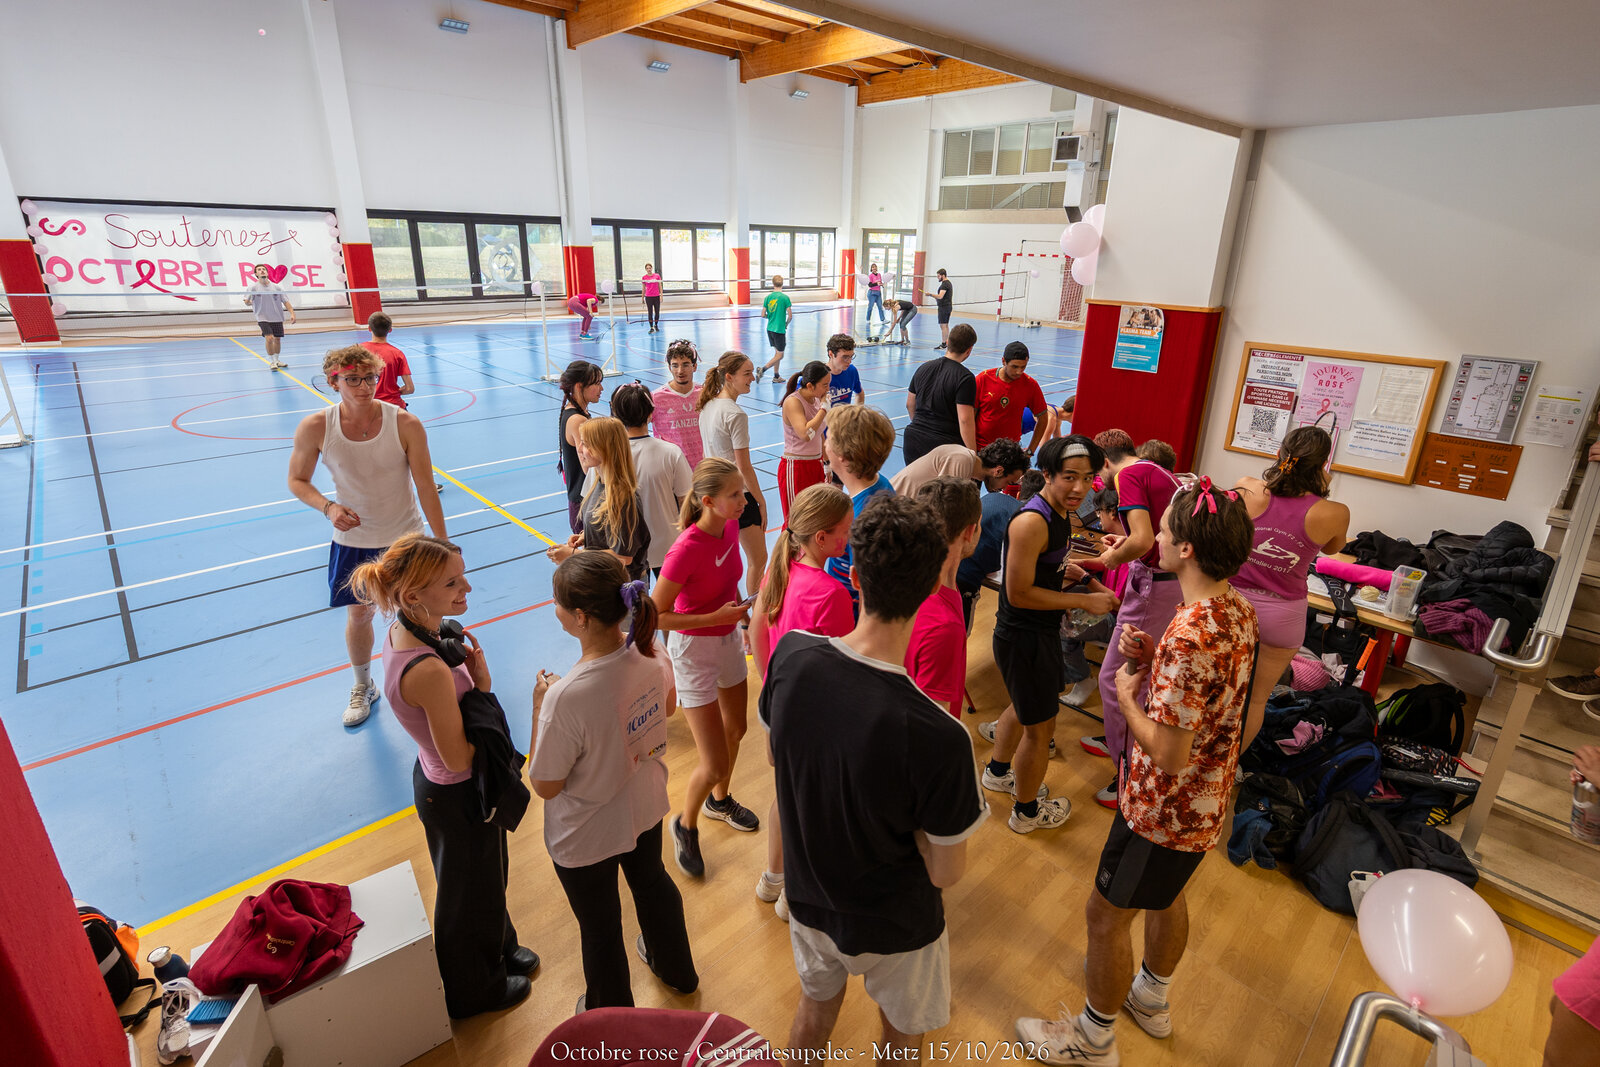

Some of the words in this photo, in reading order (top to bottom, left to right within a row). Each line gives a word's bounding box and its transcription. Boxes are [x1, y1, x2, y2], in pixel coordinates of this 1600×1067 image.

[104, 213, 296, 255] Soutenez
[1313, 366, 1356, 383] JOURNÉE
[1318, 380, 1344, 388] ROSE
[669, 418, 700, 429] ZANZIB
